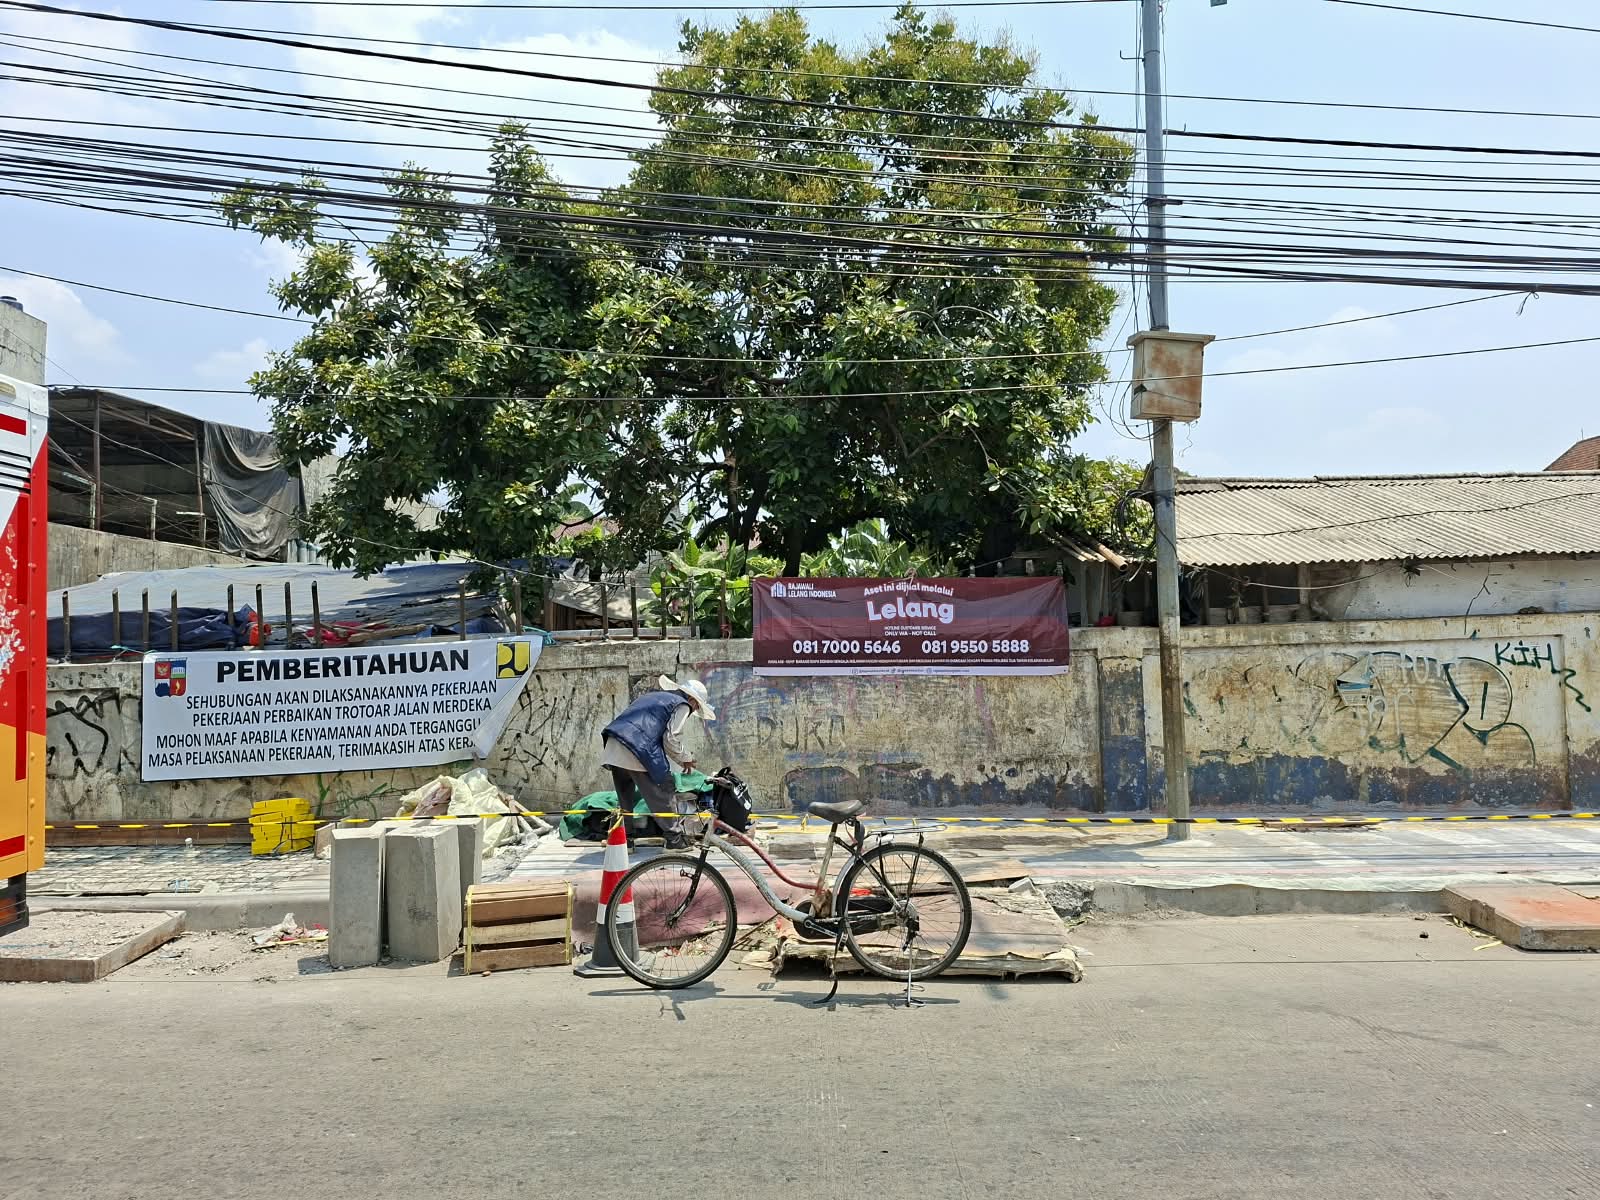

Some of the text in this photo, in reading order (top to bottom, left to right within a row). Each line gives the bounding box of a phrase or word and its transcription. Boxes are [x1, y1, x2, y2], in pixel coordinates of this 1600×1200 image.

[788, 590, 837, 598] LELANG INDONESIA
[863, 581, 954, 596] Aset ini dijual melalui
[867, 597, 954, 624] Lelang
[793, 640, 901, 653] 081 7000 5646
[922, 639, 1030, 653] 081 9550 5888
[217, 649, 469, 683] PEMBERITAHUAN
[186, 680, 497, 709] SEHUBUNGAN AKAN DILAKSANAKANNYA PEKERJAAN
[193, 697, 492, 727] PEKERJAAN PERBAIKAN TROTOAR JALAN MERDEKA
[156, 733, 201, 749] MOHON
[204, 731, 238, 747] MAAF
[240, 729, 288, 744] APABILA
[291, 724, 372, 742] KENYAMANAN
[374, 722, 408, 737] ANDA
[148, 752, 183, 768] MASA
[185, 748, 265, 765] PELAKSANAAN
[268, 744, 335, 761] PEKERJAAN,
[338, 740, 416, 758] TERIMAKASIH
[417, 737, 446, 753] ATAS
